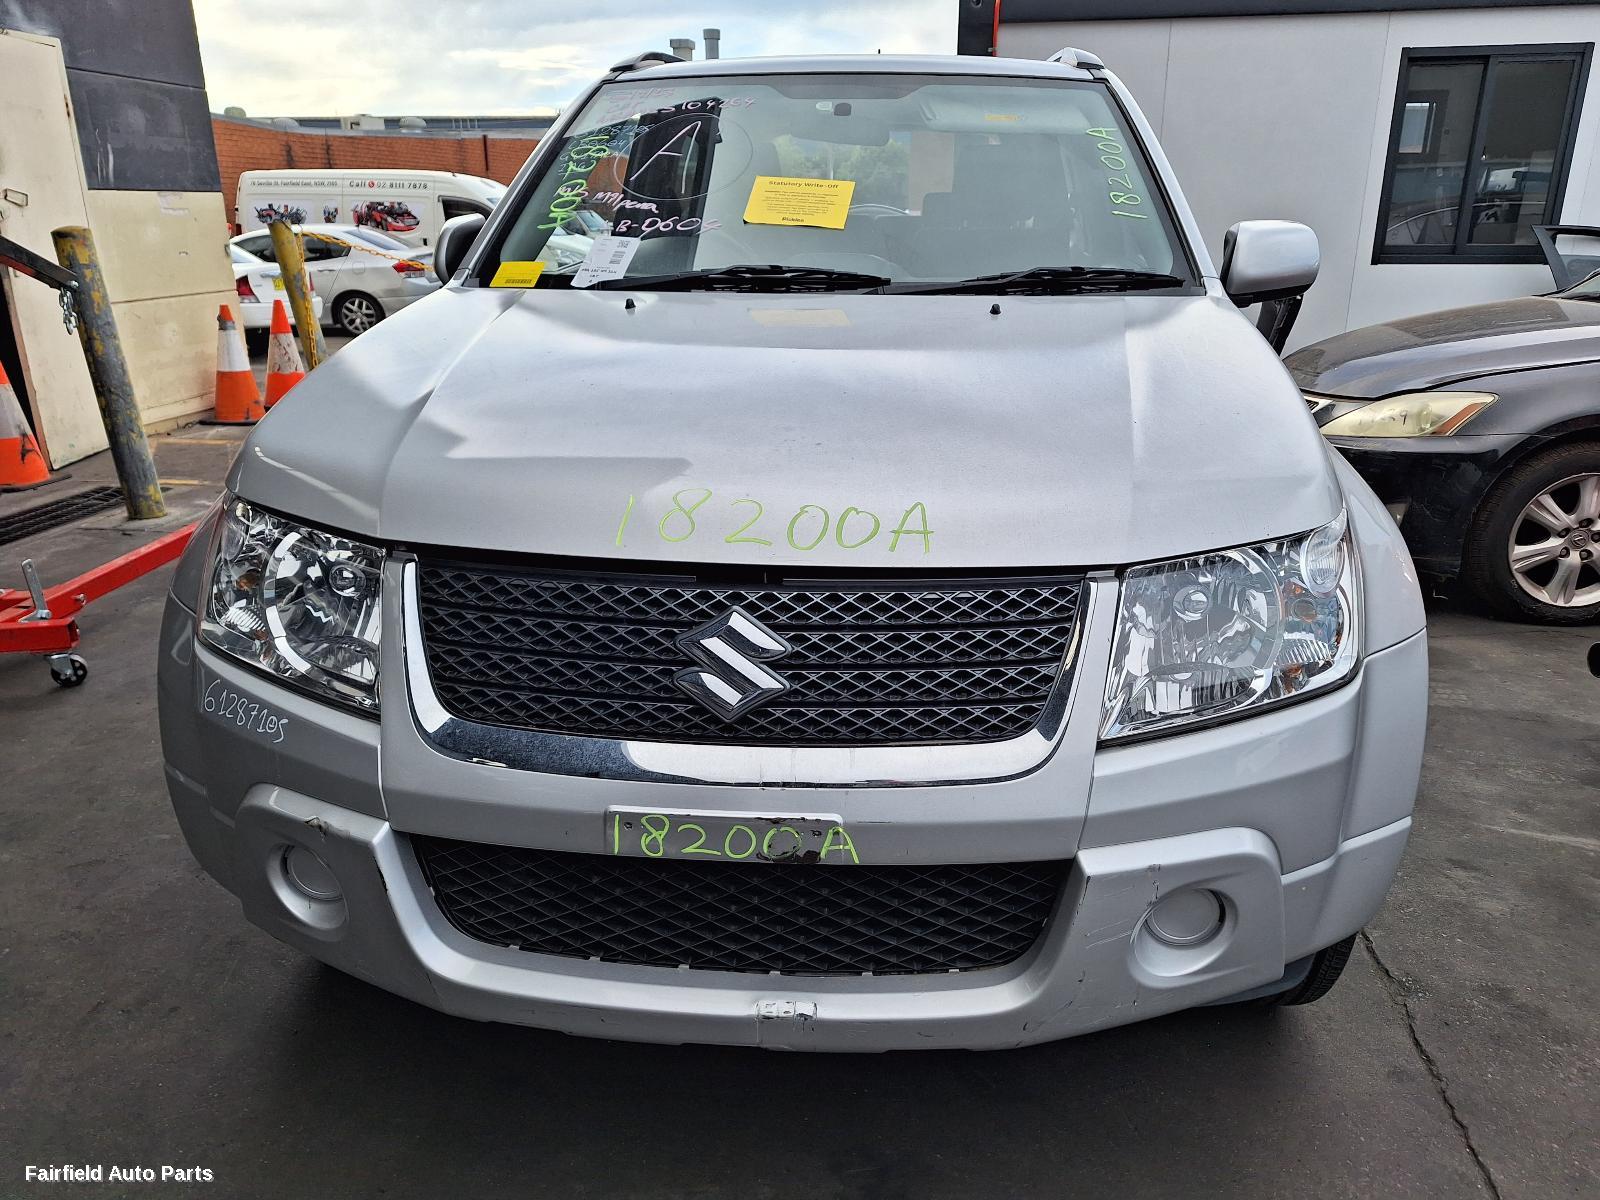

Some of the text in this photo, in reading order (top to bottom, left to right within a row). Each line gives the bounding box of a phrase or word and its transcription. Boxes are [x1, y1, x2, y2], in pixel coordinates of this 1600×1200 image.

[349, 180, 366, 188] Call
[629, 120, 702, 193] A
[769, 180, 802, 188] Statutory
[1086, 127, 1149, 219] 18200A
[615, 488, 935, 553] 18200A
[613, 813, 859, 864] 18200A
